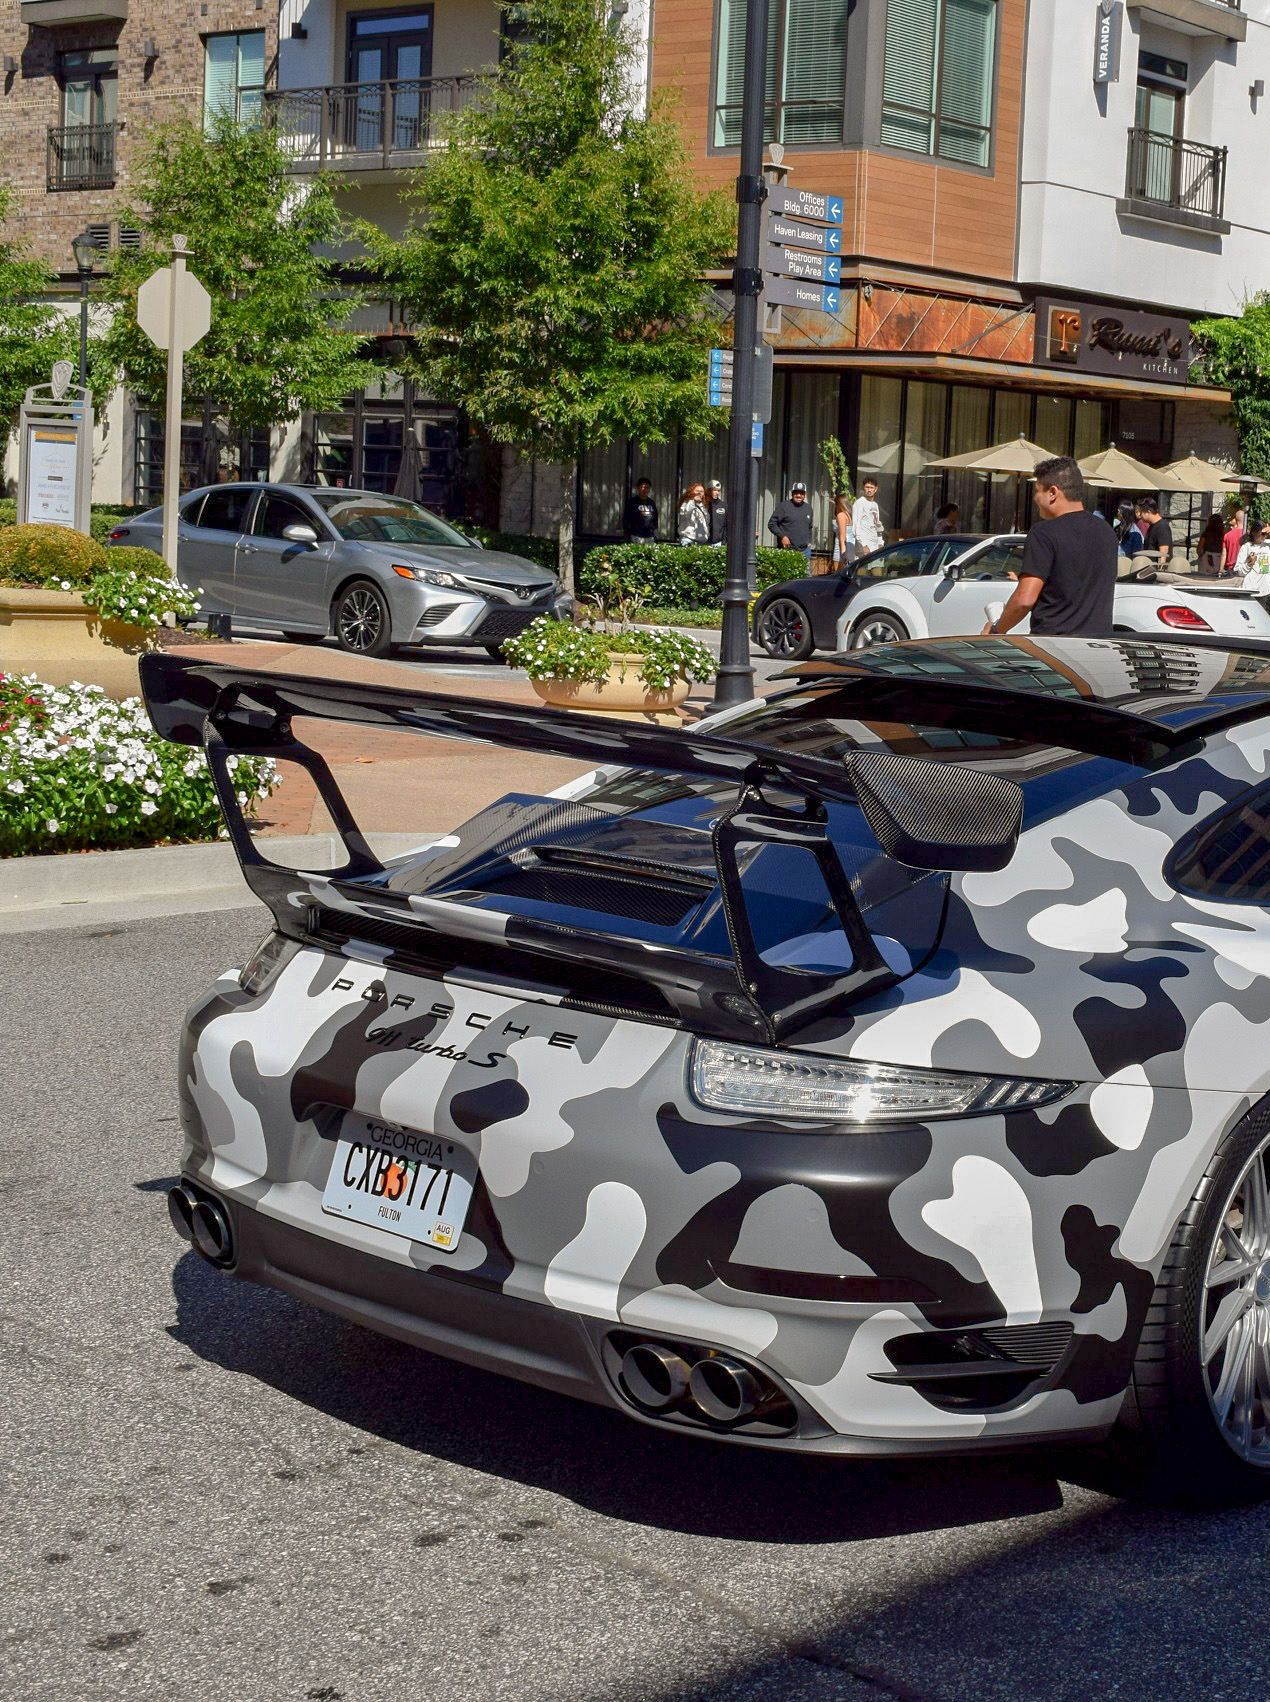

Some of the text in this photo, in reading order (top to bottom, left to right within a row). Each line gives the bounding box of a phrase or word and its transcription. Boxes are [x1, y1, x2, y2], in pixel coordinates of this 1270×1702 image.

[1098, 16, 1111, 78] VERANDA
[799, 191, 825, 206] Offices
[784, 200, 825, 218] Bldg. 6000
[774, 223, 823, 244] Haven Leasing
[784, 249, 822, 265] Restrooms
[788, 262, 822, 278] Play Area
[796, 288, 821, 302] Homes
[1142, 363, 1179, 375] KITCHEN
[331, 978, 579, 1049] PORSCHE
[407, 1035, 468, 1061] turbo
[468, 1051, 507, 1068] S
[370, 1126, 443, 1161] GEORGIA
[343, 1141, 454, 1216] CXB3171
[377, 1205, 402, 1222] FULTON
[436, 1224, 451, 1235] AUG
